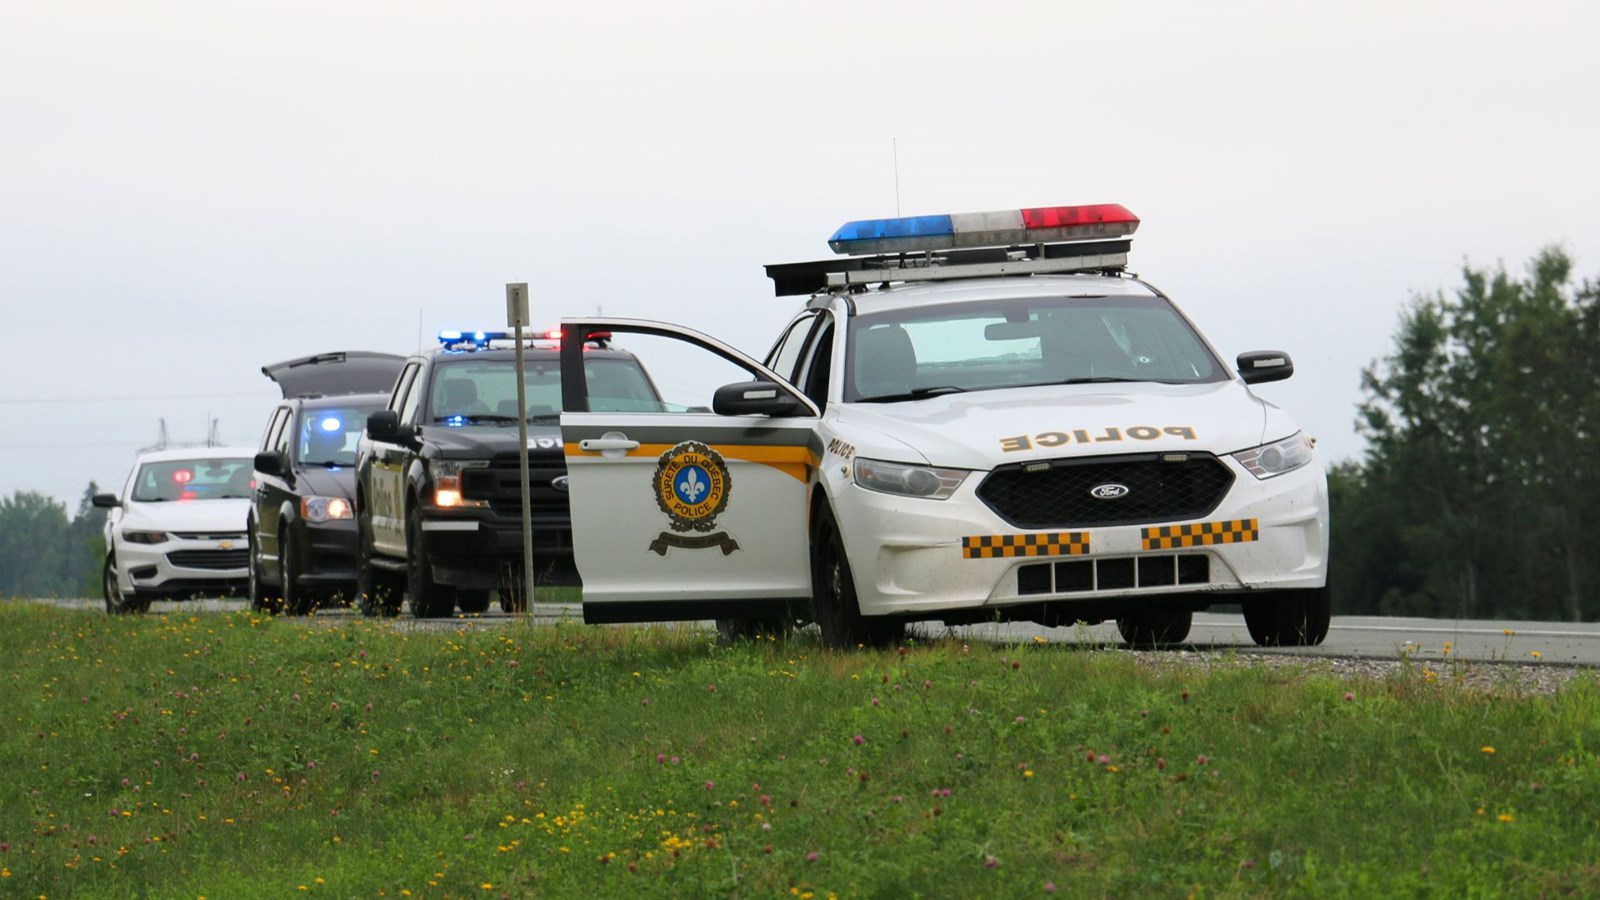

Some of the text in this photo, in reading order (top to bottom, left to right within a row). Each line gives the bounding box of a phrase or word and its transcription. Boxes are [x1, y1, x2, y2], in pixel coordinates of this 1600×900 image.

[827, 438, 855, 460] POLICE
[684, 455, 698, 464] DU
[674, 502, 712, 516] POLICE
